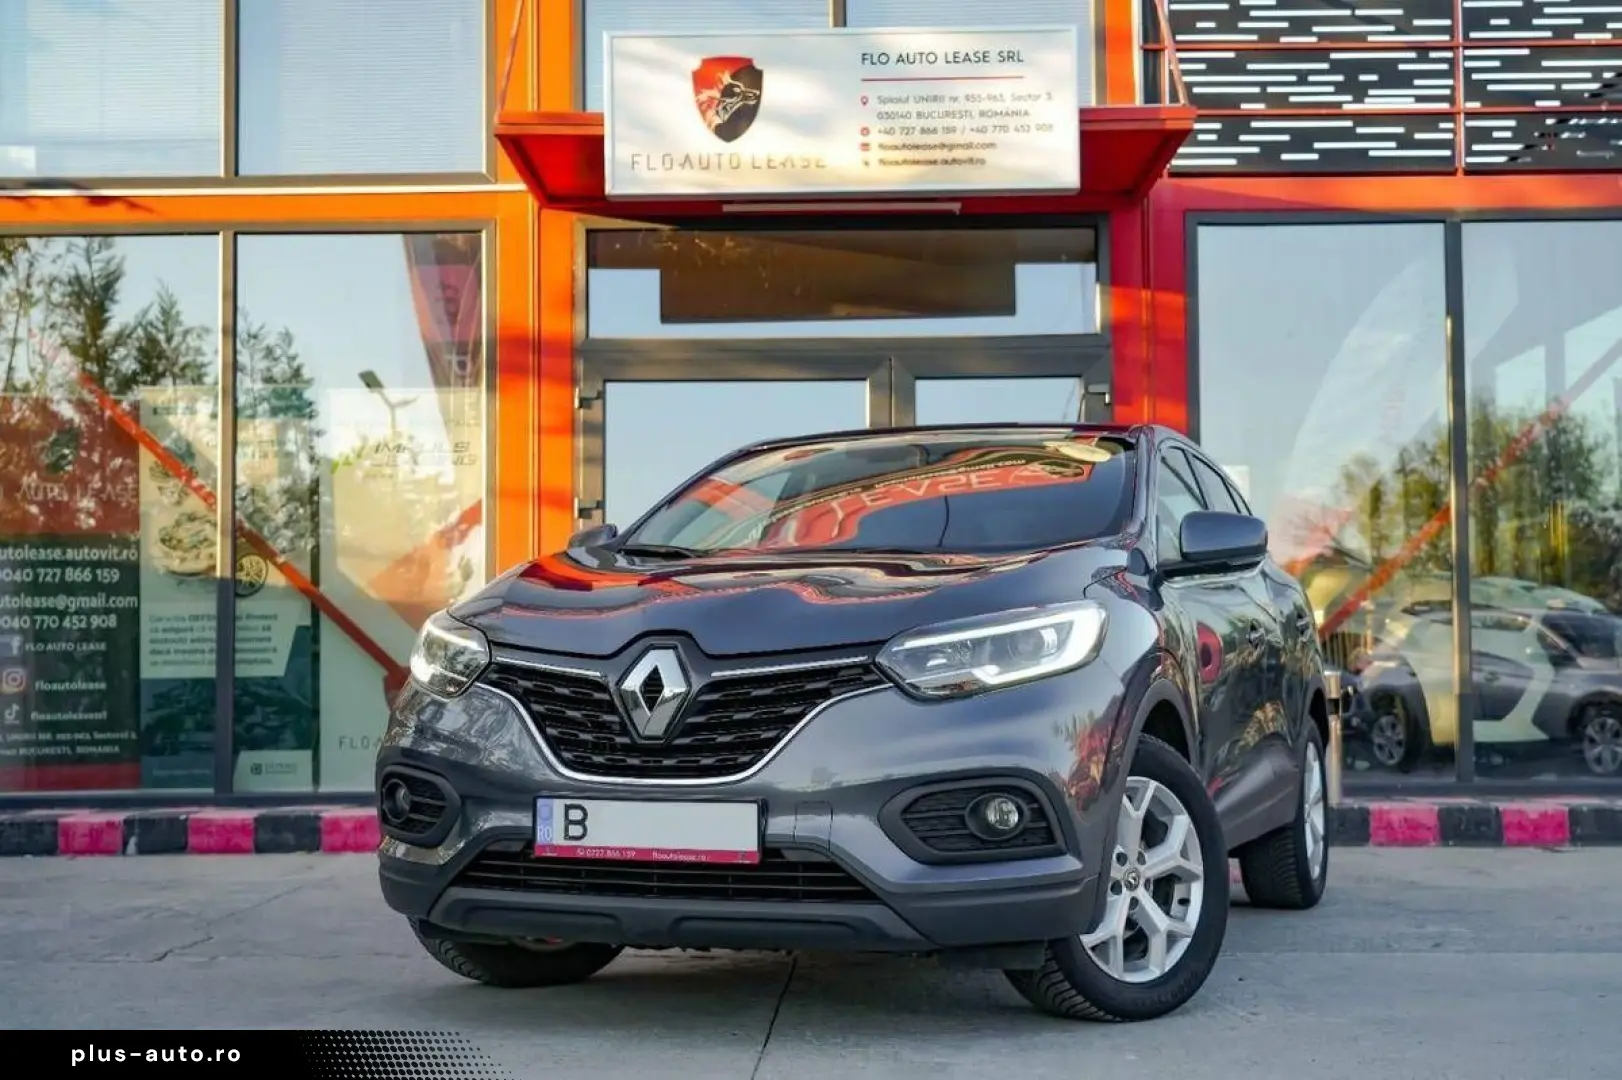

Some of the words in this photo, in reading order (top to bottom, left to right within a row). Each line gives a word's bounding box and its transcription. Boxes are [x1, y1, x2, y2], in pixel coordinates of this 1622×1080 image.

[861, 53, 890, 65] FLO
[895, 52, 938, 65] AUTO
[944, 51, 990, 64] LEASE
[997, 50, 1024, 63] SRL
[877, 126, 896, 135] +40
[899, 126, 916, 135] 727
[920, 125, 939, 135] 866
[942, 125, 957, 134] 159
[970, 125, 988, 134] +40
[991, 124, 1009, 134] 770
[1014, 124, 1031, 133] 452
[630, 153, 674, 171] FLO
[678, 153, 741, 171] AUTO
[36, 568, 61, 583] 727
[65, 567, 92, 582] 866
[96, 568, 120, 583] 159
[34, 615, 59, 630] 770
[62, 614, 88, 629] 452
[90, 613, 117, 628] 908
[25, 642, 44, 652] FLO
[46, 641, 75, 652] AUTO
[76, 641, 107, 651] LEASE
[35, 680, 107, 692] floautolease
[338, 735, 370, 750] FLO
[538, 826, 553, 841] RO
[563, 803, 589, 841] B
